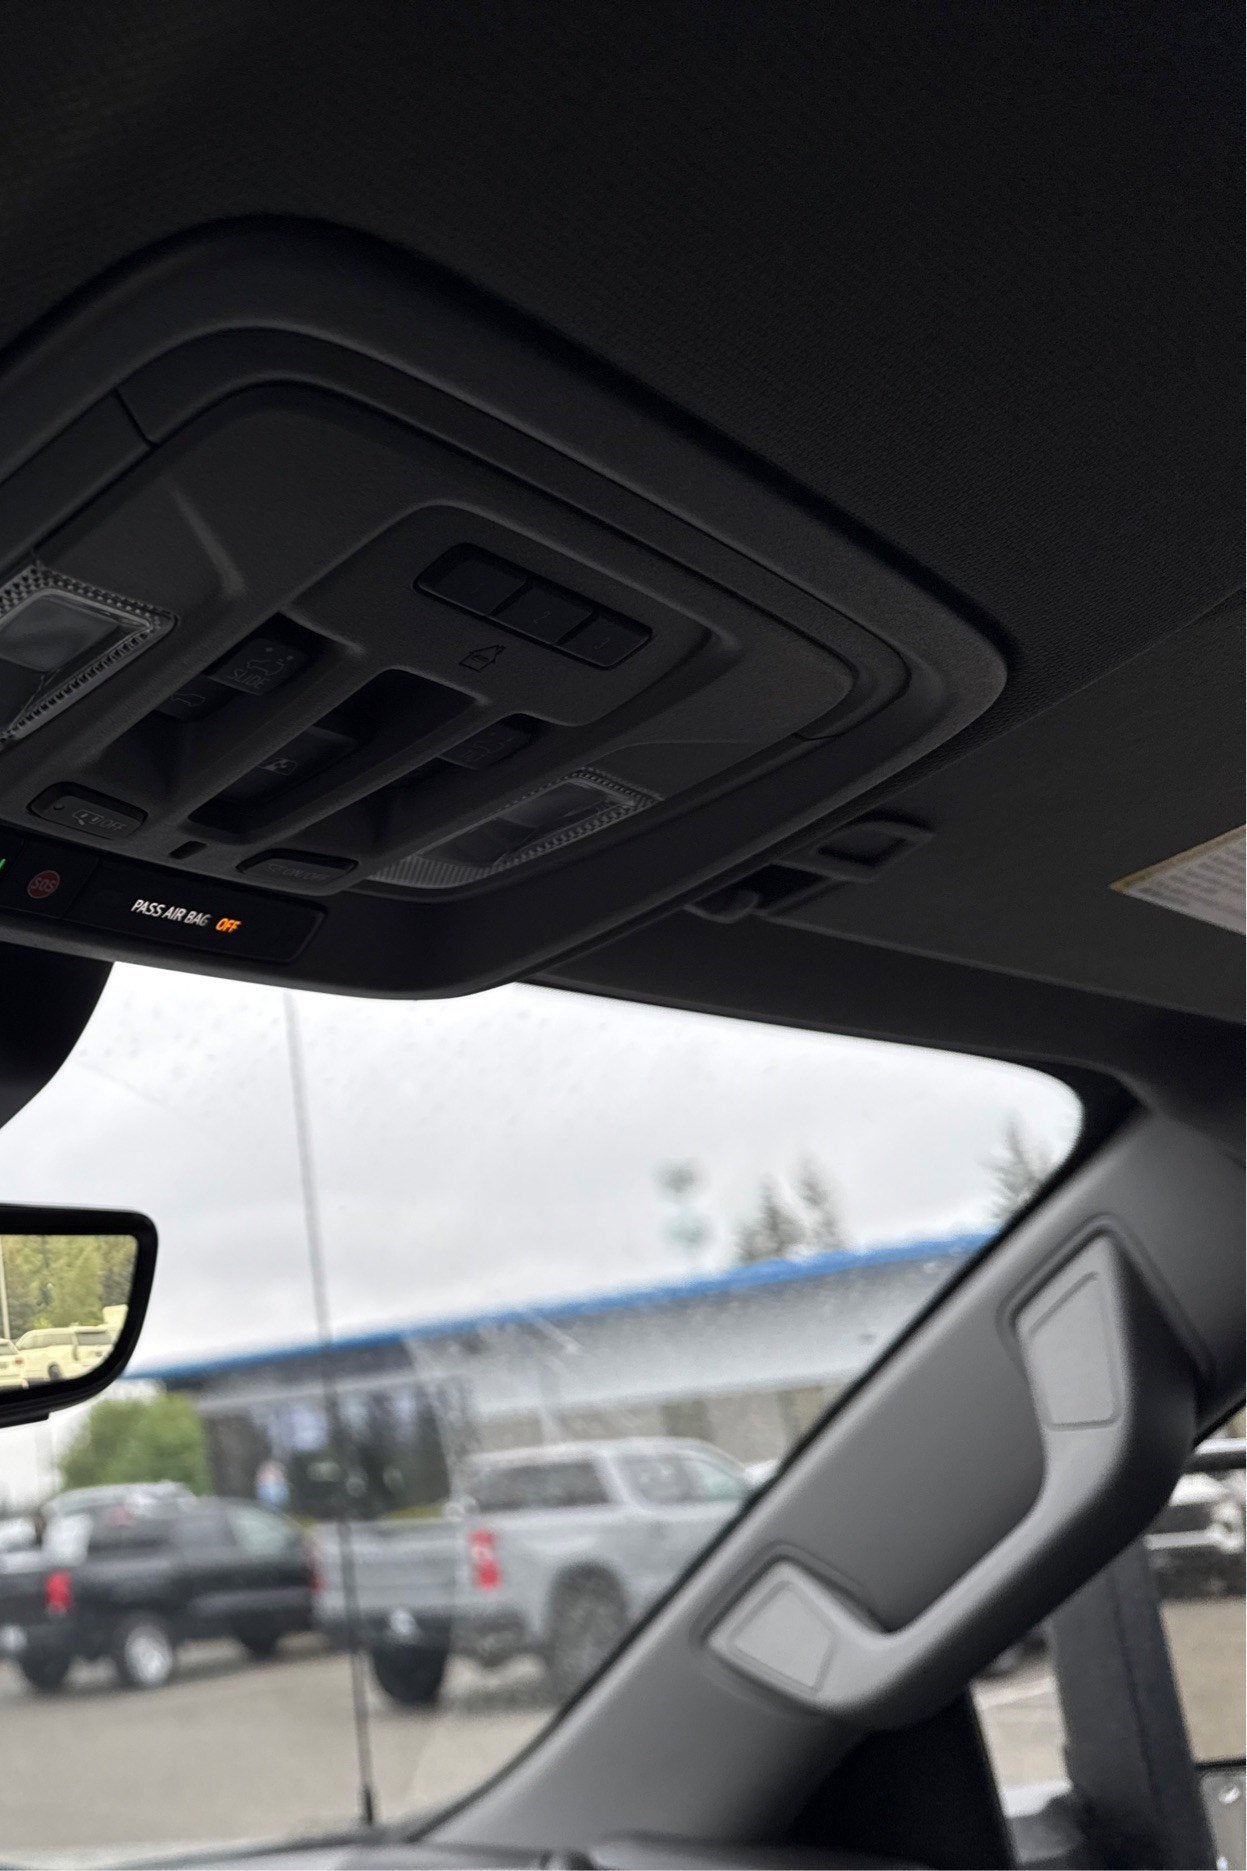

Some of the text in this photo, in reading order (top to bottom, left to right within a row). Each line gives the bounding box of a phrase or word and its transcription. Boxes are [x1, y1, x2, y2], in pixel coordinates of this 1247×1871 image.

[226, 668, 270, 690] SLIDE
[99, 819, 128, 832] OFF
[31, 876, 57, 892] SOS
[130, 899, 243, 933] PASS AIR BAG OFF
